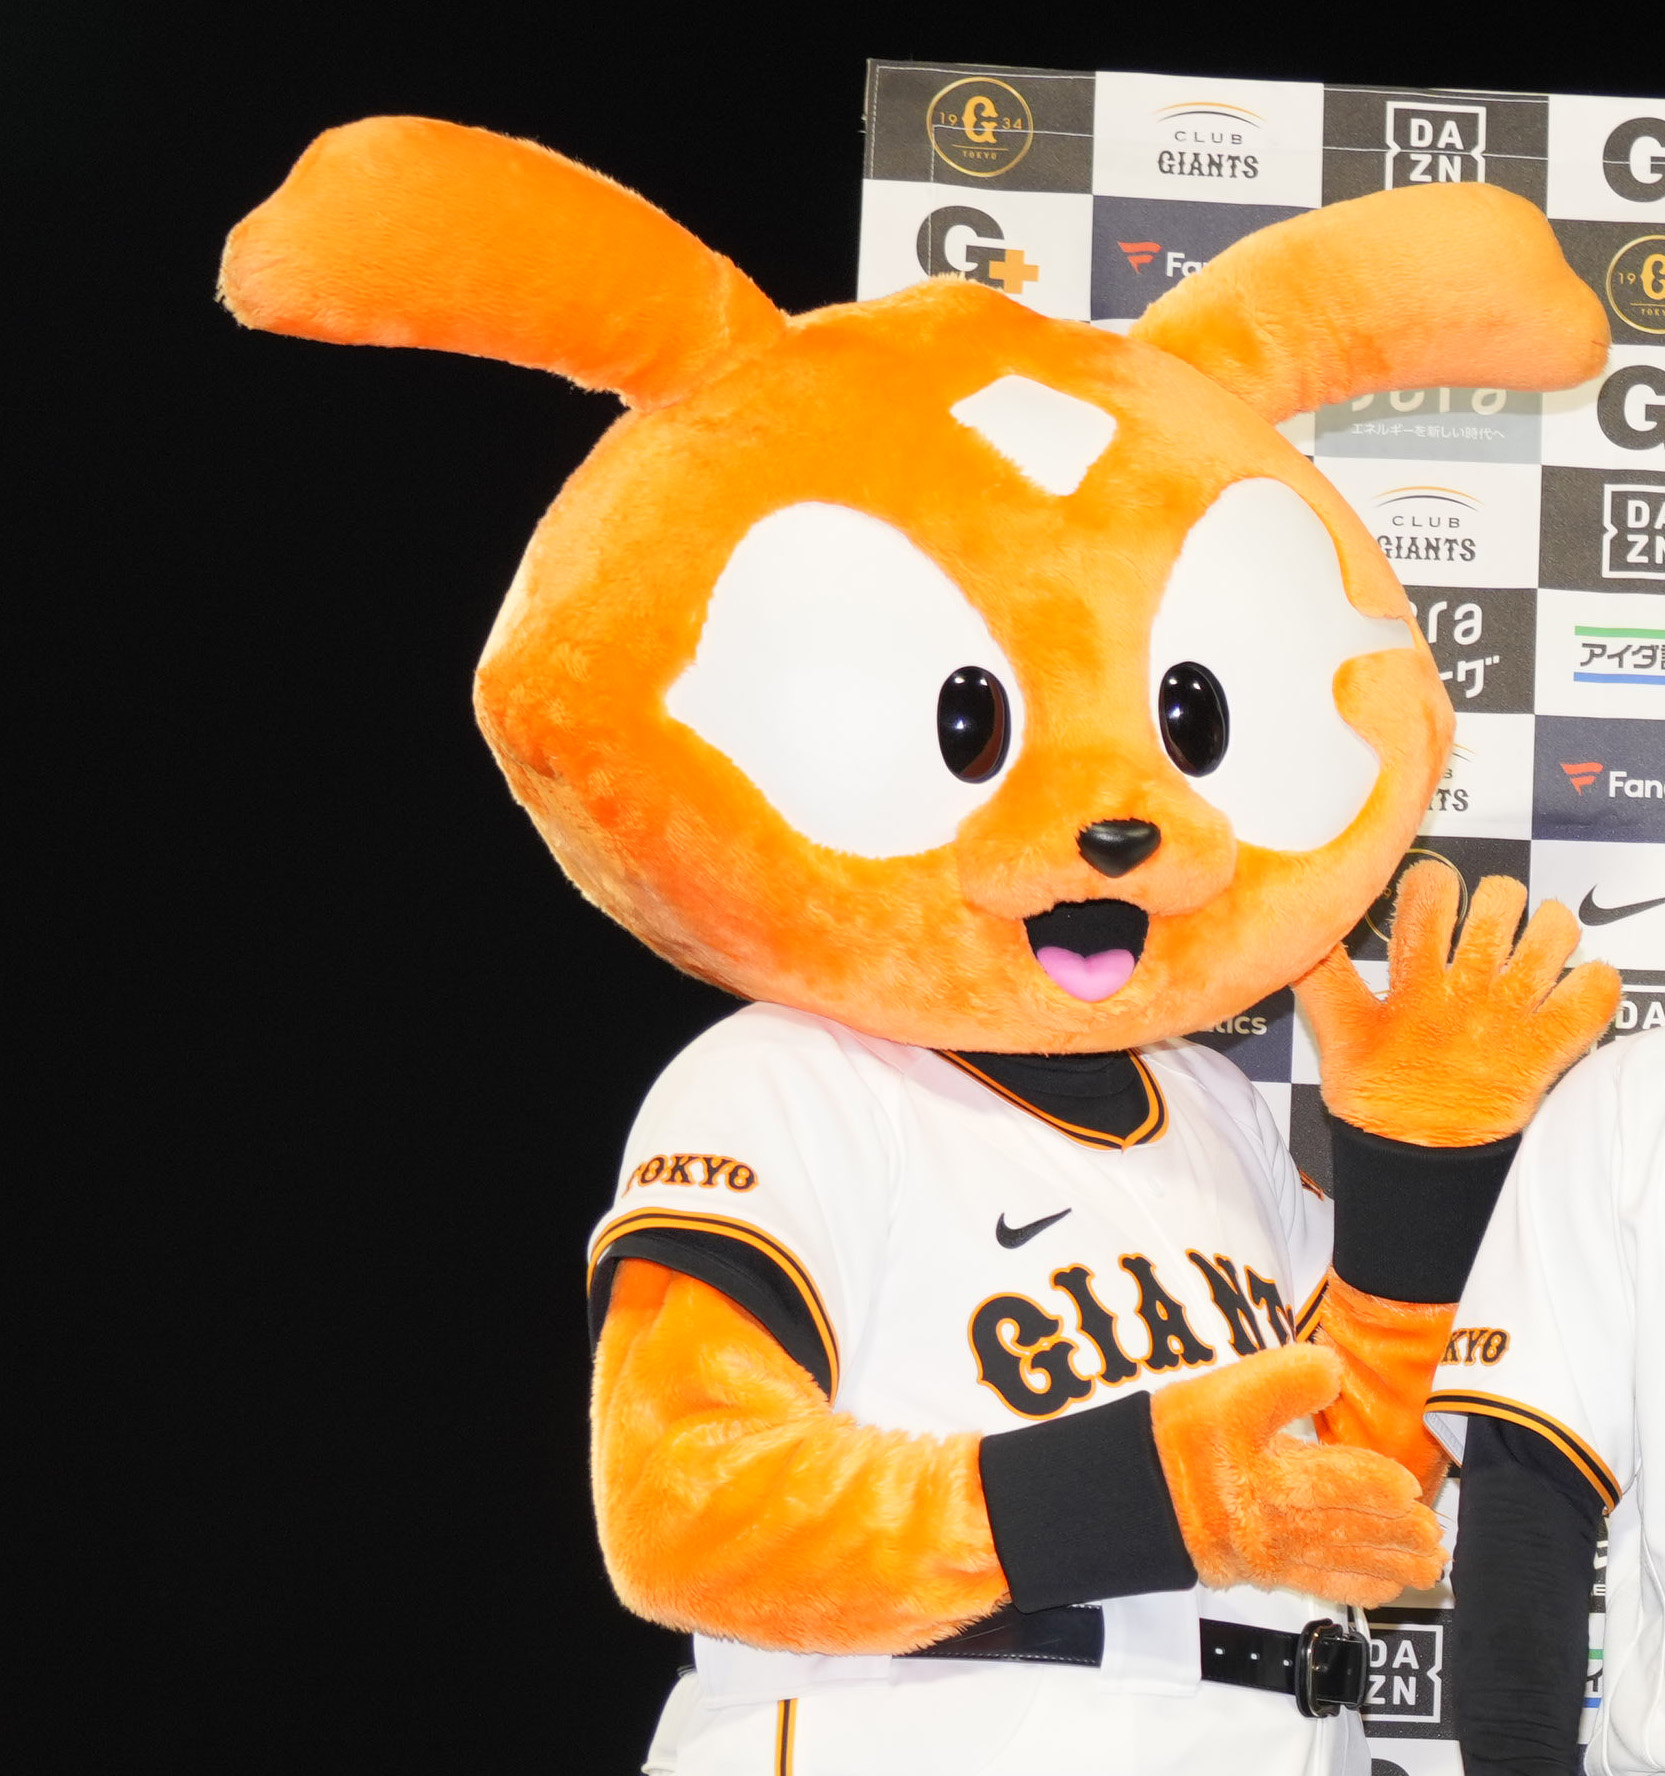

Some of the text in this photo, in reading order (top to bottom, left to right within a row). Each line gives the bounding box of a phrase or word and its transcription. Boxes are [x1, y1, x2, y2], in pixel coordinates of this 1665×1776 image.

[1173, 129, 1242, 145] CLUB
[1156, 149, 1258, 179] GIANTS
[967, 1248, 1298, 1421] GIANT
